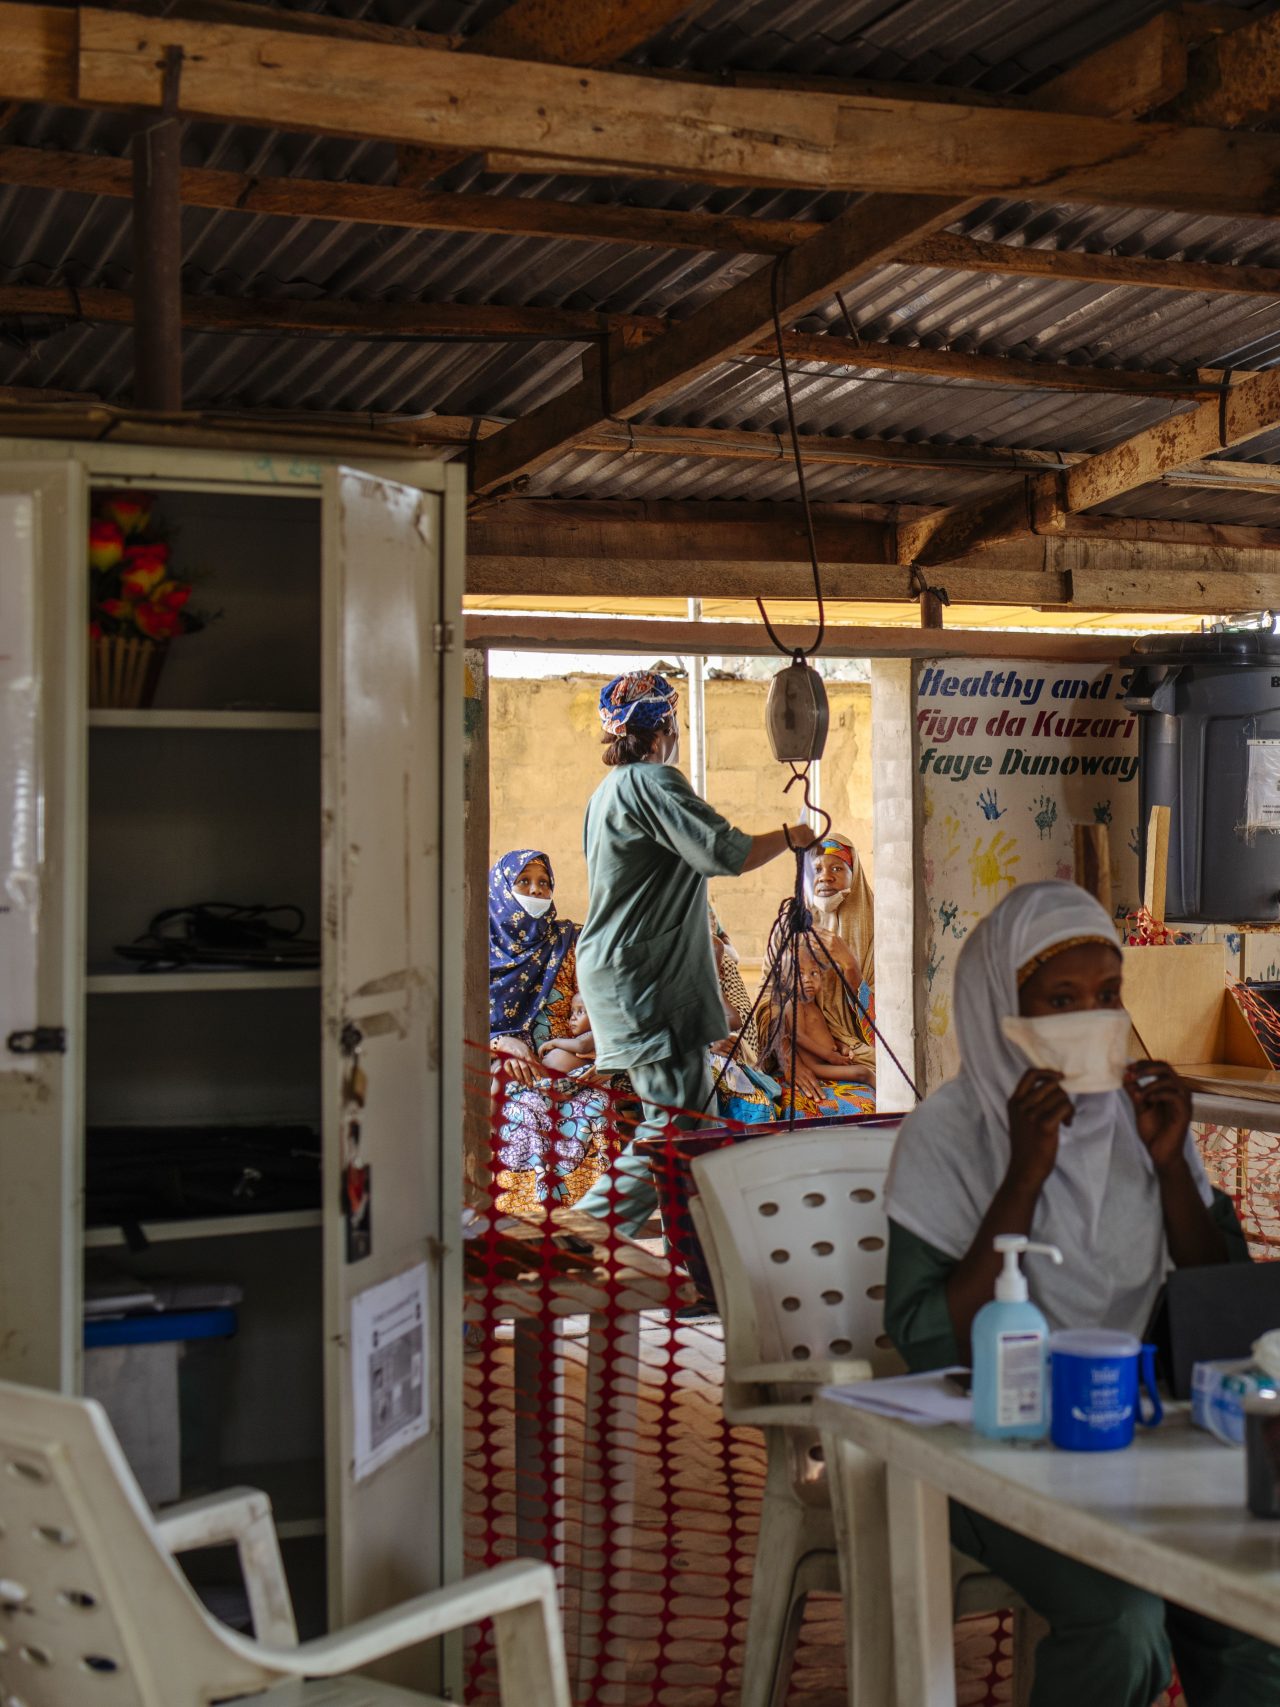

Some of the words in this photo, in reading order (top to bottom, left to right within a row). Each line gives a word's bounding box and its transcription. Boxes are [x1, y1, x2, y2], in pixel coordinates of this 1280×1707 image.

[918, 668, 1046, 706] Healthy
[1051, 673, 1114, 700] and
[917, 708, 979, 743] fiya
[985, 710, 1027, 737] da
[1031, 710, 1138, 738] Kuzari
[918, 748, 993, 782] faye
[998, 748, 1140, 783] Dunoway
